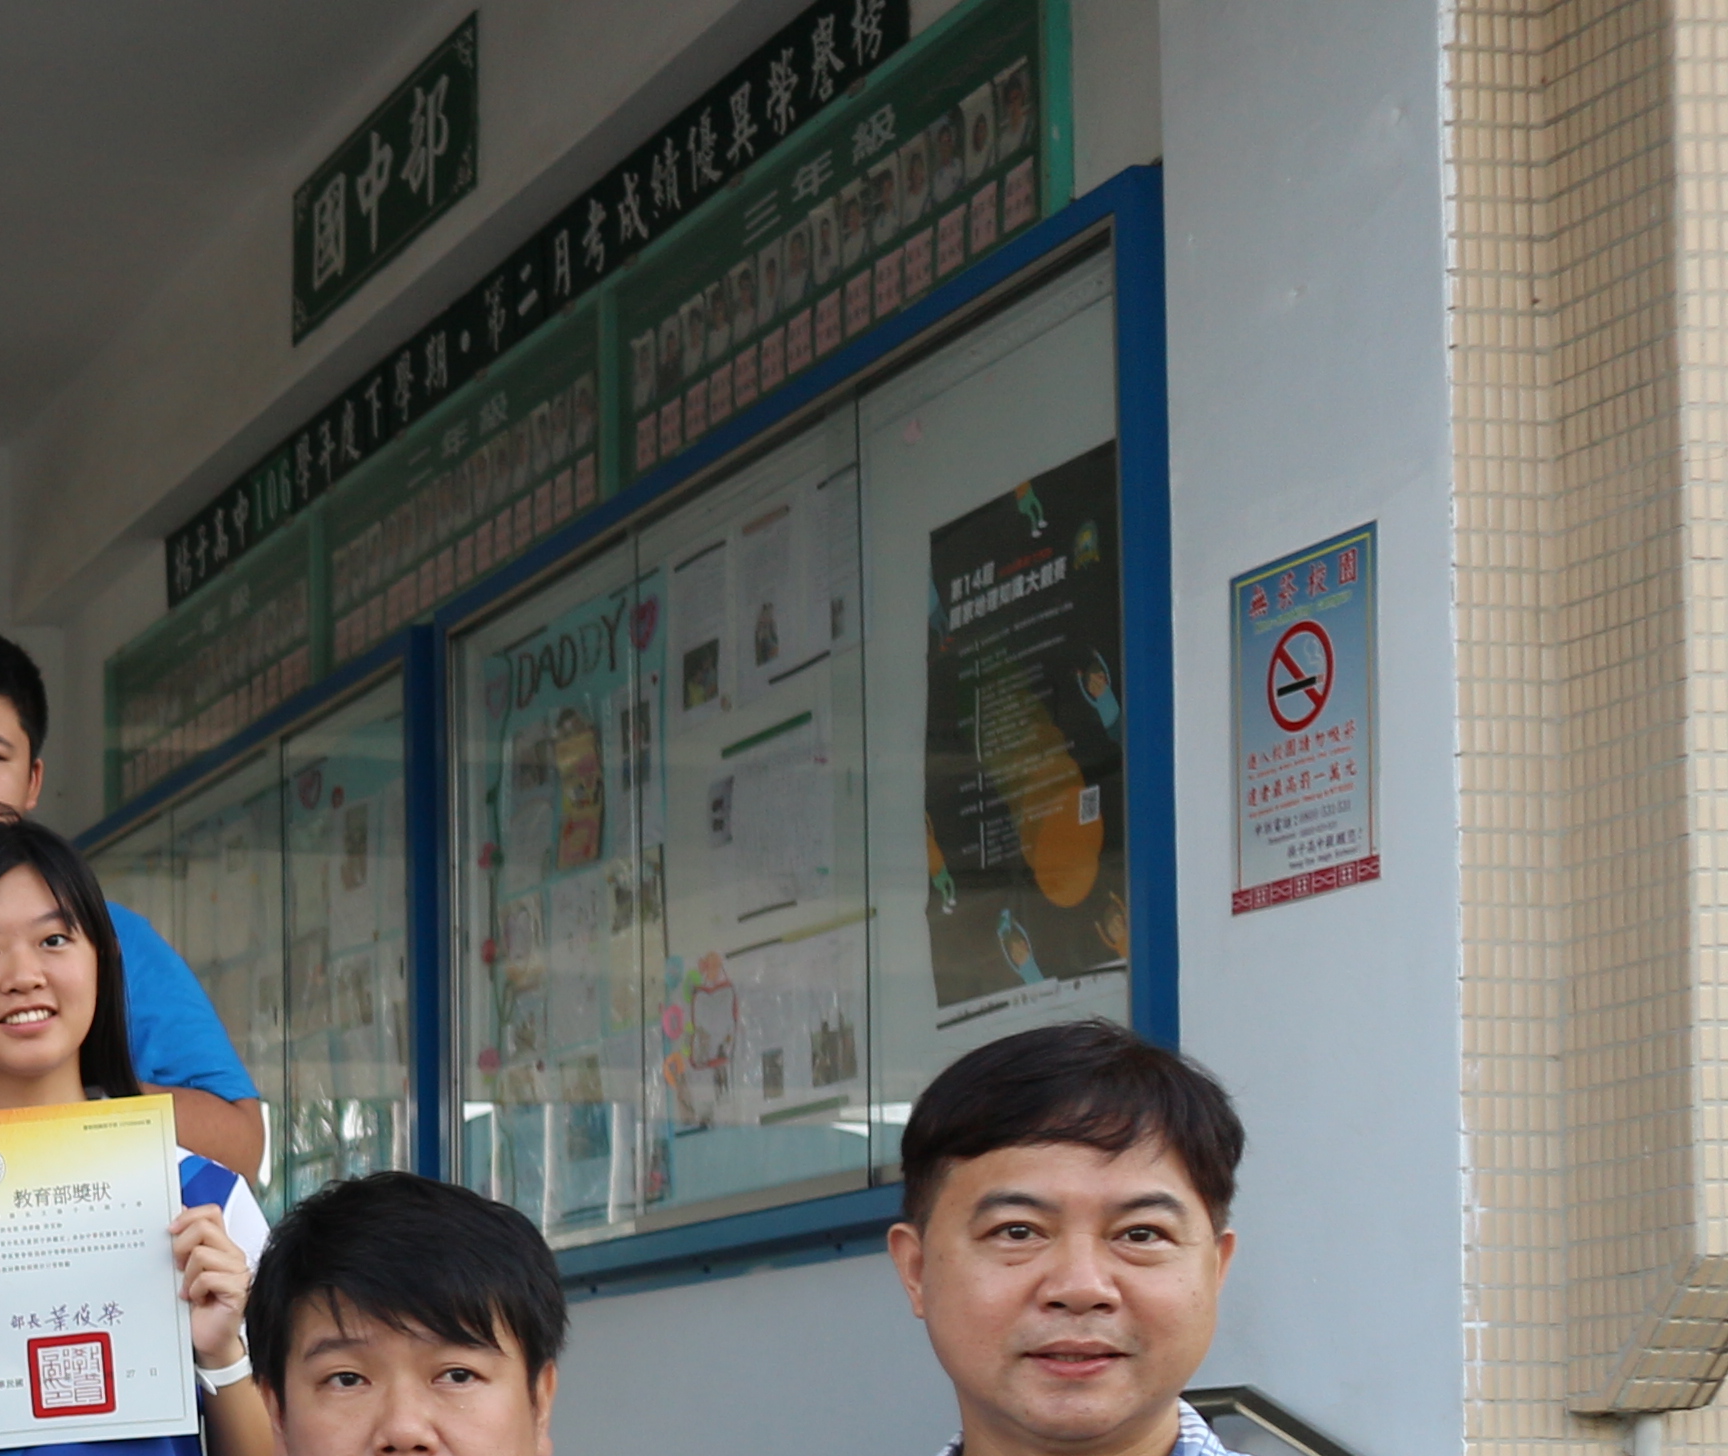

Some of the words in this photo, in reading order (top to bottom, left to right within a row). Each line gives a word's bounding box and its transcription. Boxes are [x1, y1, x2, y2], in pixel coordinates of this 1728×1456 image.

[310, 73, 450, 292] 國中部
[743, 103, 898, 246] 三年級
[517, 597, 627, 709] DADDY
[12, 1181, 112, 1209] 教育部獎狀
